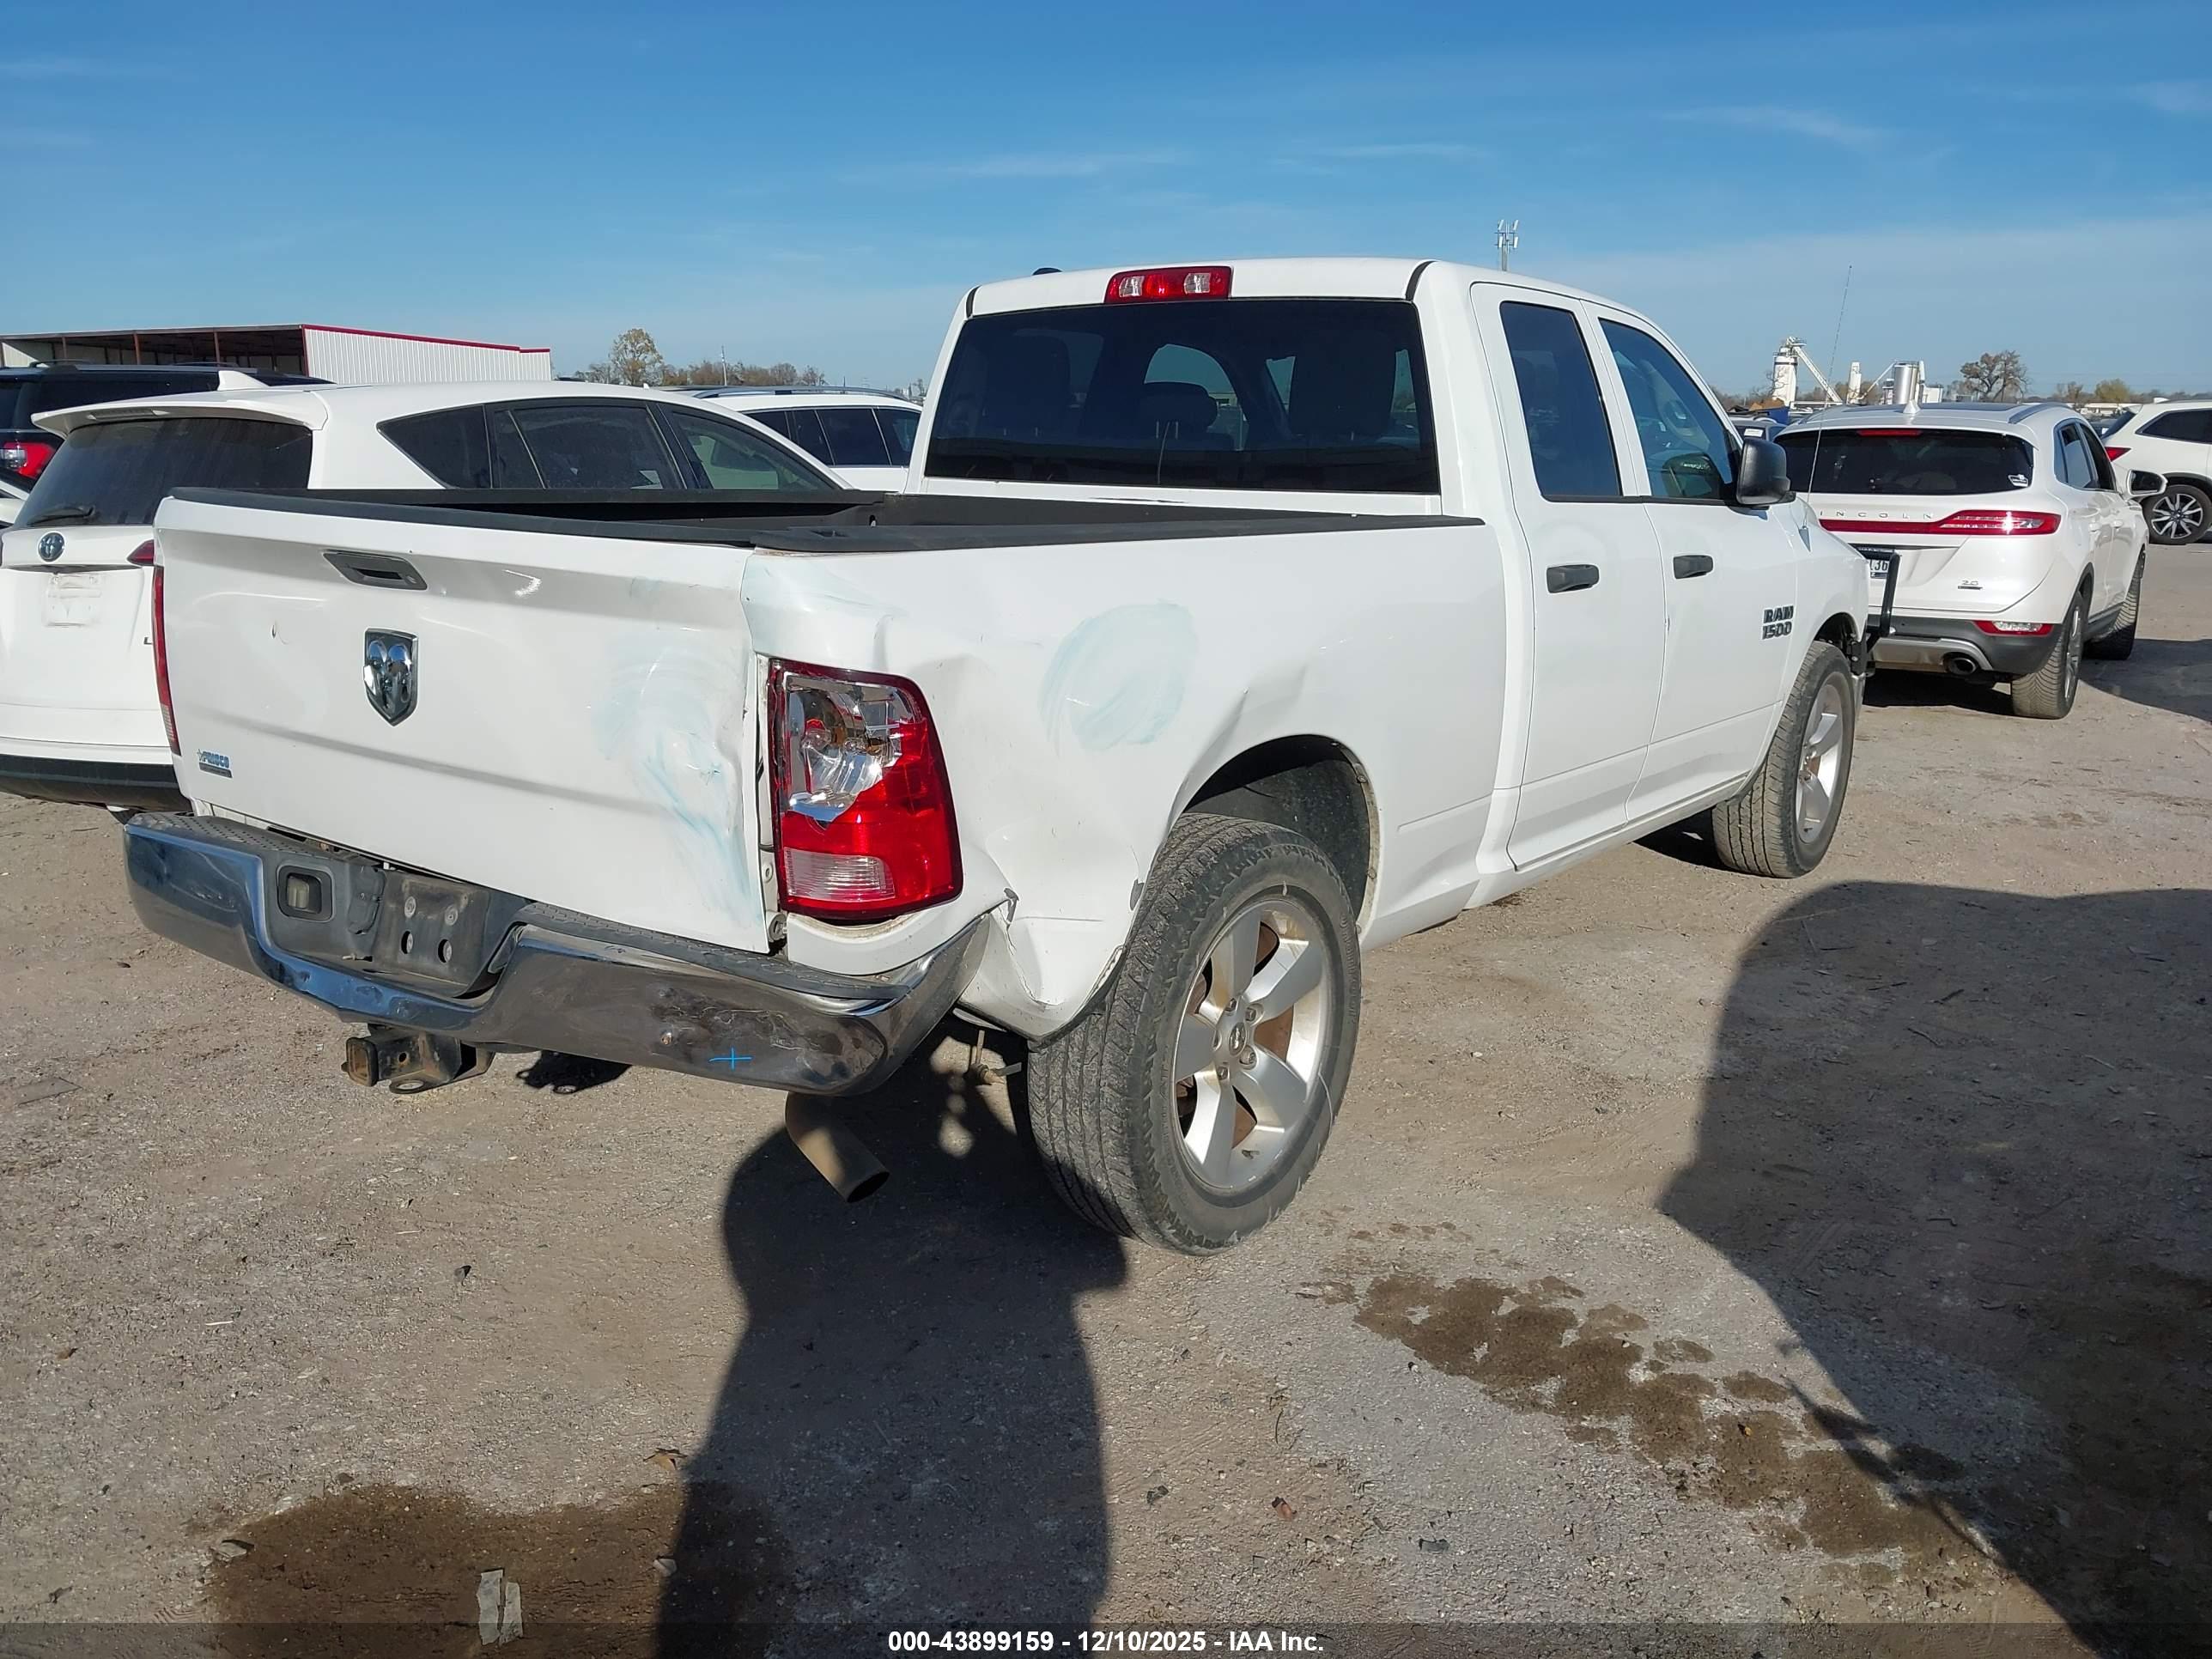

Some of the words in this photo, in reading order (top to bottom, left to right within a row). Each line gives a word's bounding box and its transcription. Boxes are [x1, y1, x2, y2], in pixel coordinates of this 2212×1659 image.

[1819, 510, 1932, 520] INCOLN
[1763, 605, 1794, 624] RAM
[1762, 621, 1792, 641] 1500
